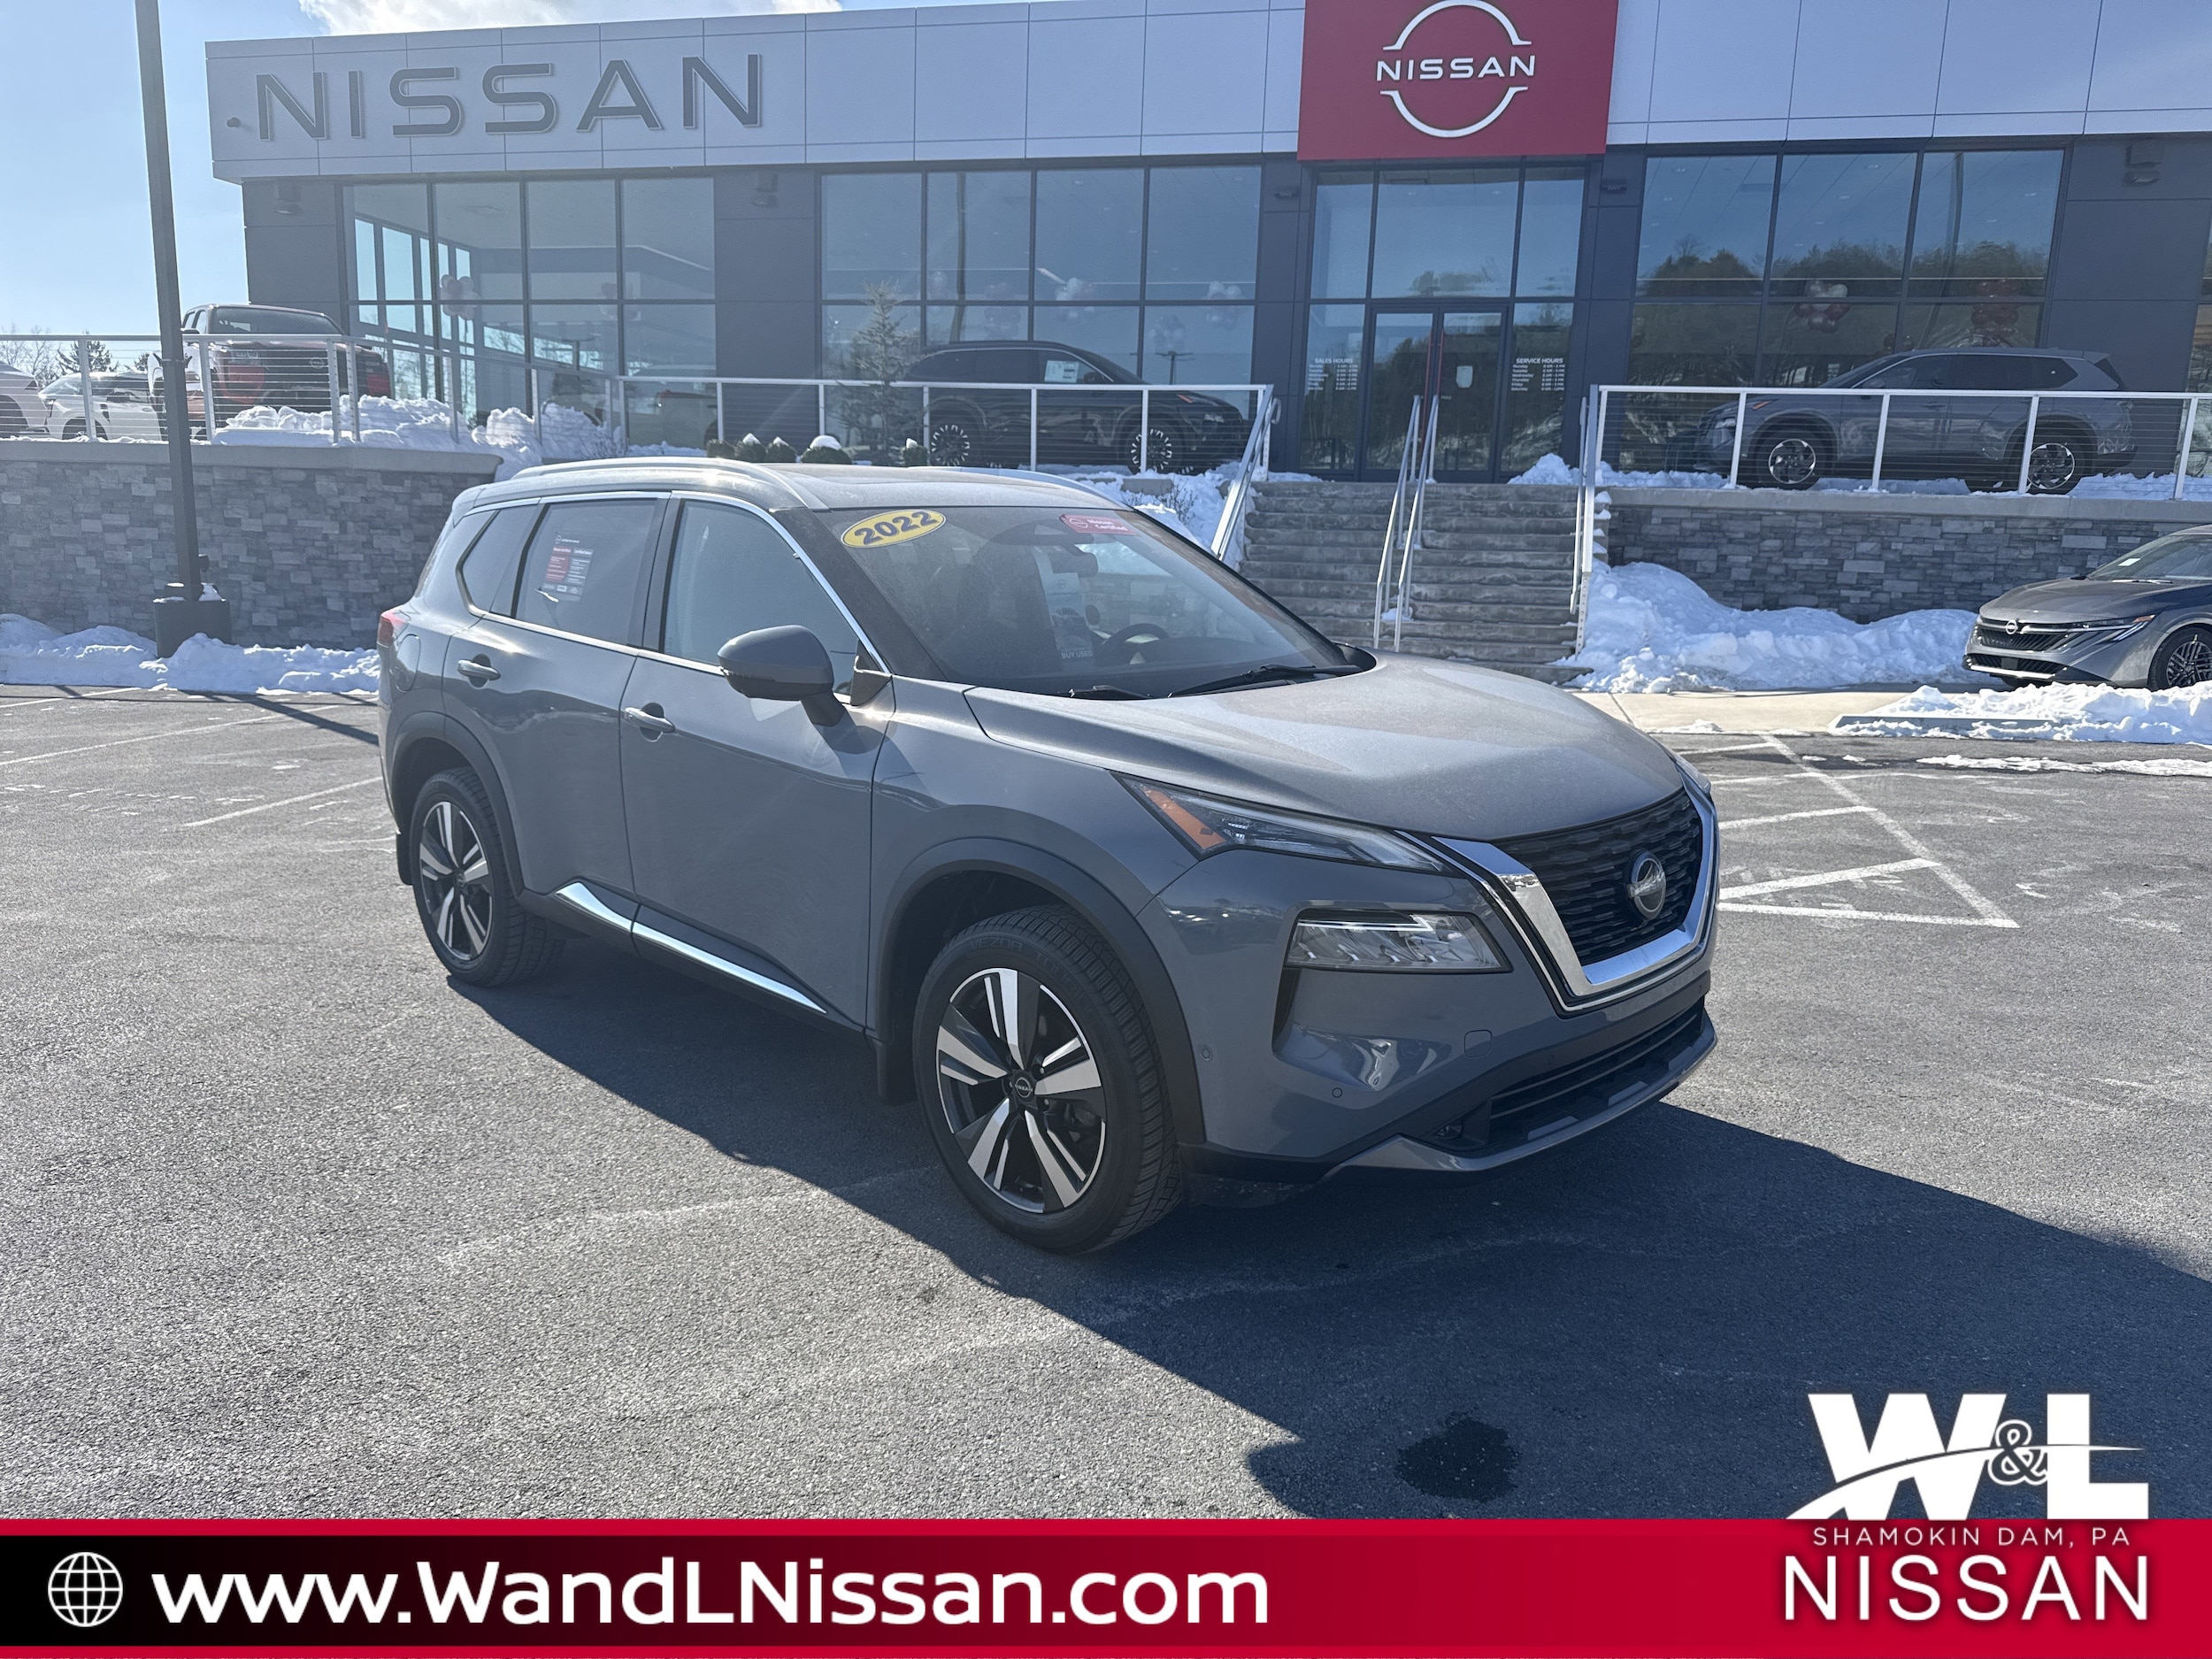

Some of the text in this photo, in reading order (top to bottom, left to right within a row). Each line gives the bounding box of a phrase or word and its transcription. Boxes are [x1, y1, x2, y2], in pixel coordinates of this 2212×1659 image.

[1376, 55, 1536, 81] NISSAN
[256, 53, 763, 142] NISSAN
[854, 511, 938, 545] 2022
